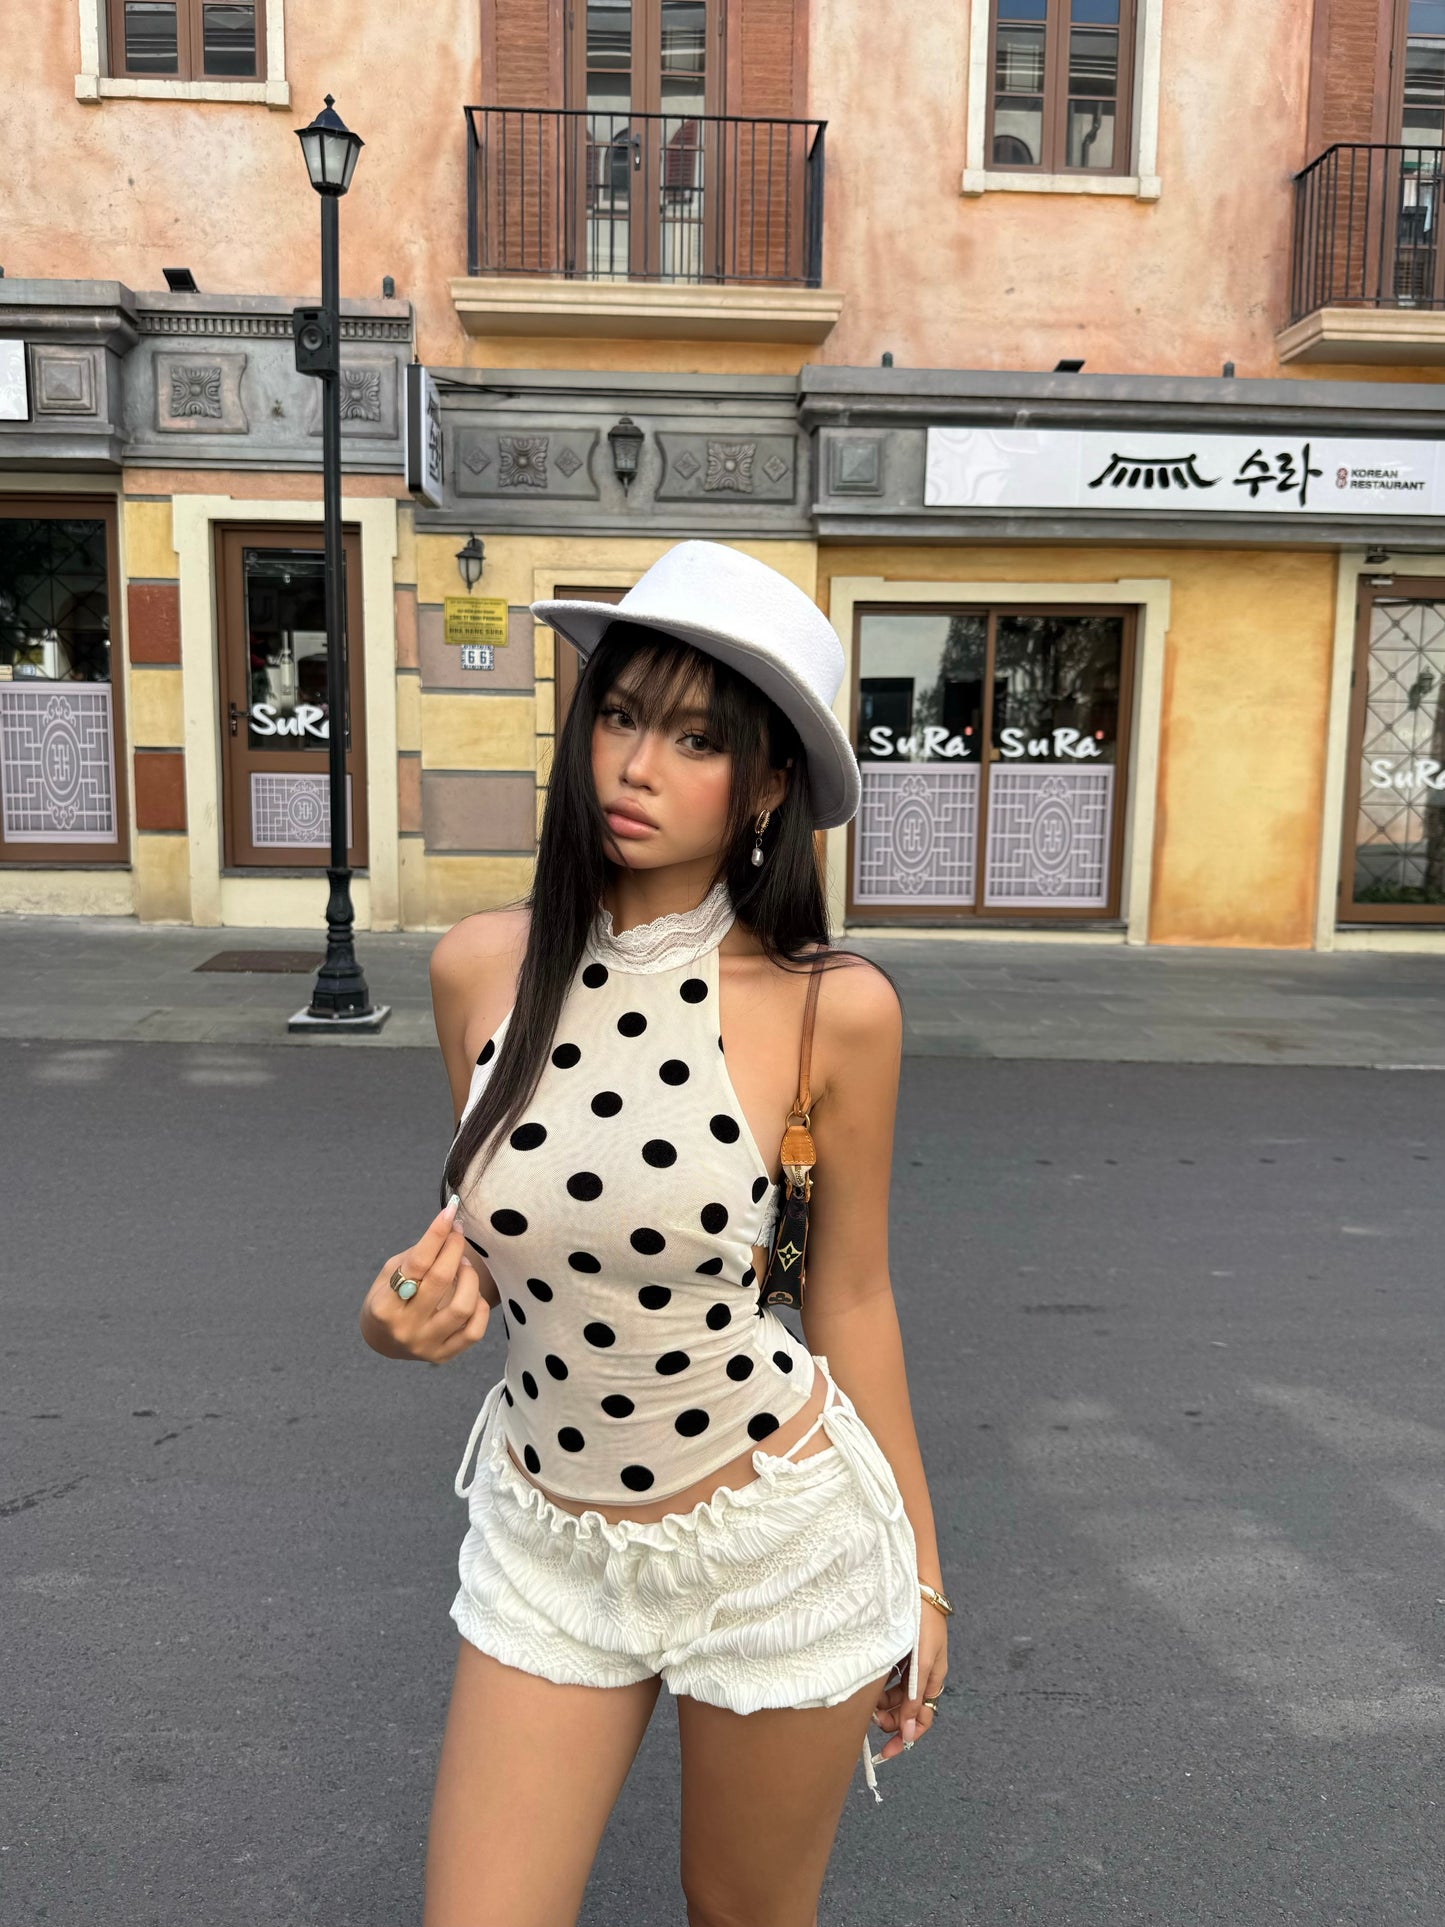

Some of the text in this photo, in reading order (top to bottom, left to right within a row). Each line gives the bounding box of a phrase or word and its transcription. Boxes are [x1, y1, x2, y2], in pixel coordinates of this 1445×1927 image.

[1233, 443, 1323, 508] 수라
[1350, 469, 1399, 478] KOREAN
[1350, 480, 1425, 490] RESTAURANT
[869, 725, 971, 756] SuRa
[1000, 727, 1102, 758] SuRa
